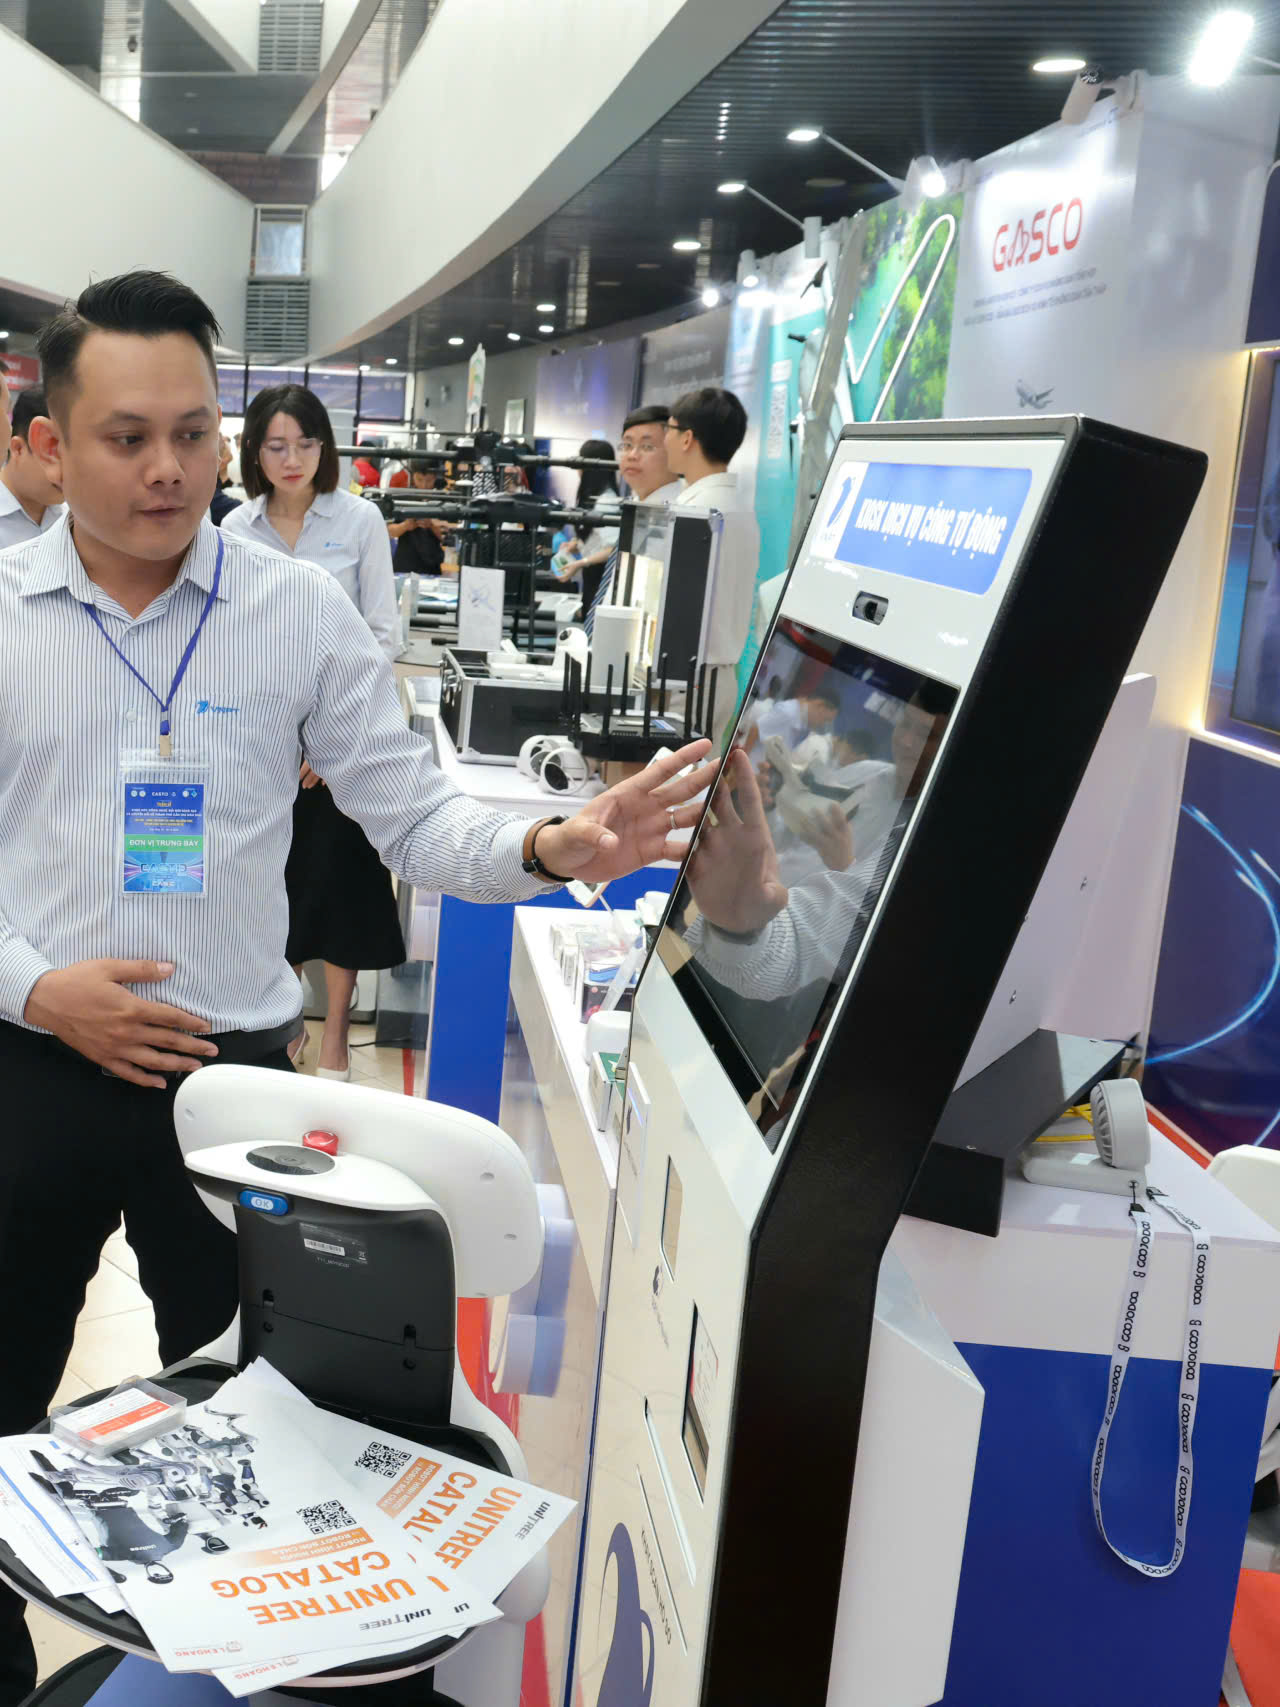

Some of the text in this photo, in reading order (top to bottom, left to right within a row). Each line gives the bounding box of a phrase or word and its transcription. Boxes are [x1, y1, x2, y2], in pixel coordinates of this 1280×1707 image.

[992, 197, 1083, 272] GASCO
[880, 501, 912, 542] DỊCH
[918, 500, 957, 546] CÔNG
[948, 508, 976, 556] TỰ
[963, 506, 1008, 560] ĐỘNG
[255, 1198, 270, 1209] OK
[323, 1533, 351, 1545] ROBOT
[335, 1536, 367, 1548] ROBOT
[209, 1551, 391, 1598] CATALOG
[247, 1578, 416, 1625] UNITREE
[359, 1607, 432, 1631] UNITREE
